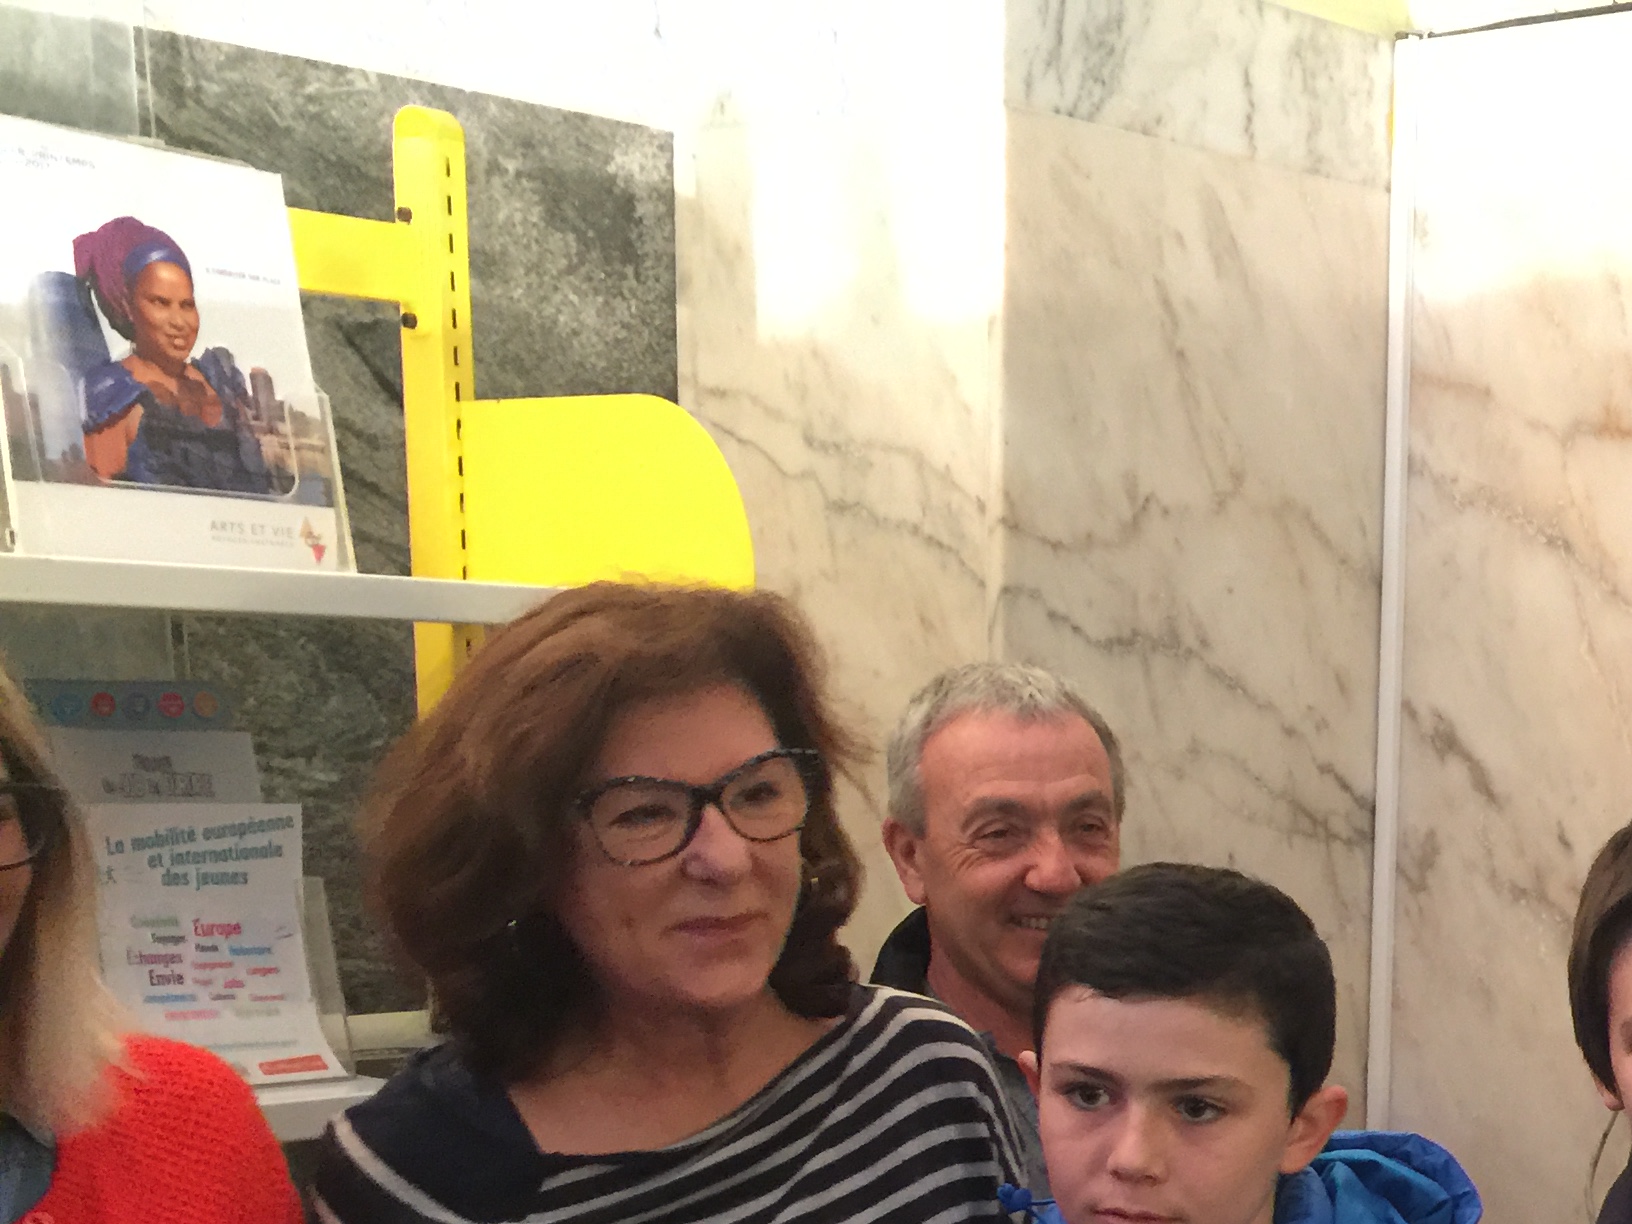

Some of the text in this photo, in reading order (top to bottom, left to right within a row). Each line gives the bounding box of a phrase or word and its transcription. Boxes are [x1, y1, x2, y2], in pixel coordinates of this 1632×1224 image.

[210, 519, 294, 539] ARTS ET VIE
[105, 814, 295, 856] La mobilité européenne
[147, 839, 283, 868] et internationale
[161, 867, 248, 891] des jeunes
[192, 918, 242, 938] Europe
[148, 969, 184, 986] Envie
